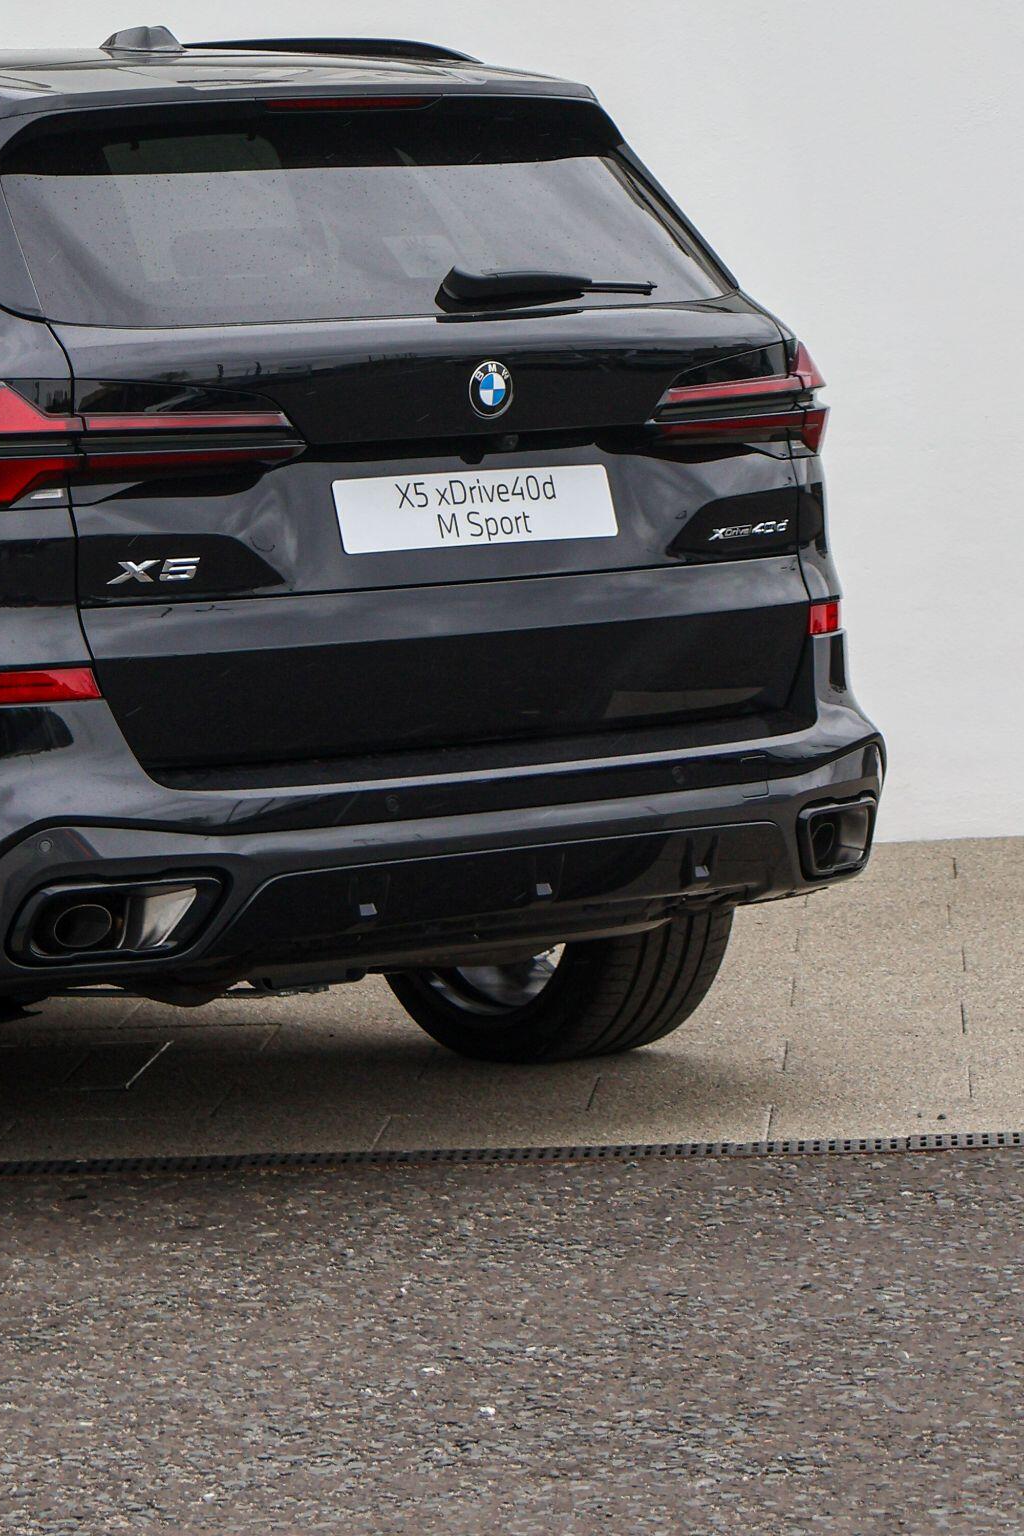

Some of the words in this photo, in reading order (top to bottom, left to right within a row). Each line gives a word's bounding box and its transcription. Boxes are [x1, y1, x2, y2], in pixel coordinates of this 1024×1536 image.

[474, 363, 510, 381] BMW
[394, 481, 428, 509] X5
[435, 474, 557, 506] xDrive40d
[436, 512, 460, 539] M
[466, 510, 532, 541] Sport
[106, 556, 201, 585] X5
